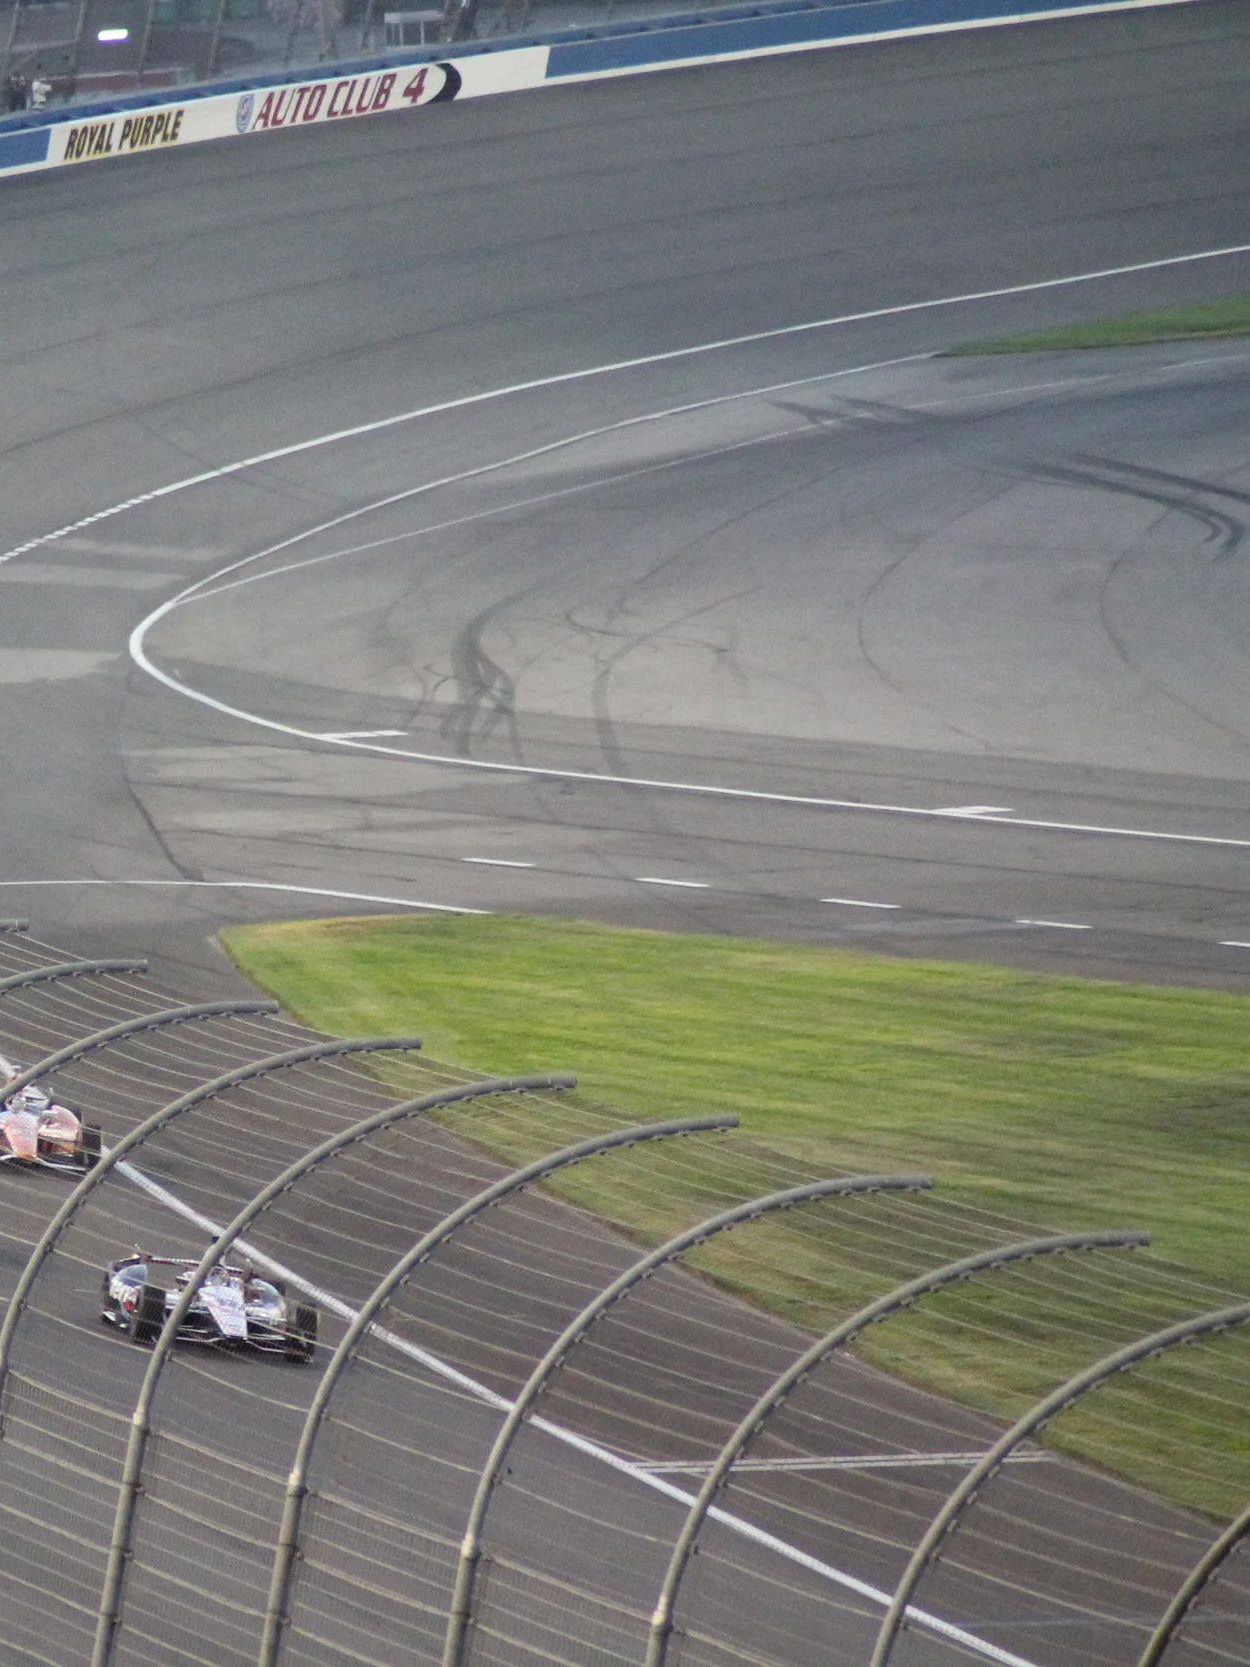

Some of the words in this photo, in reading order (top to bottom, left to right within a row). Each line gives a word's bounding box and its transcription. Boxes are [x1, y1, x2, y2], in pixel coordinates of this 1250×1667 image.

[251, 84, 327, 130] AUTO
[327, 73, 397, 117] CLUB
[402, 68, 429, 105] 4
[63, 122, 115, 161] ROYAL
[119, 110, 185, 150] PURPLE
